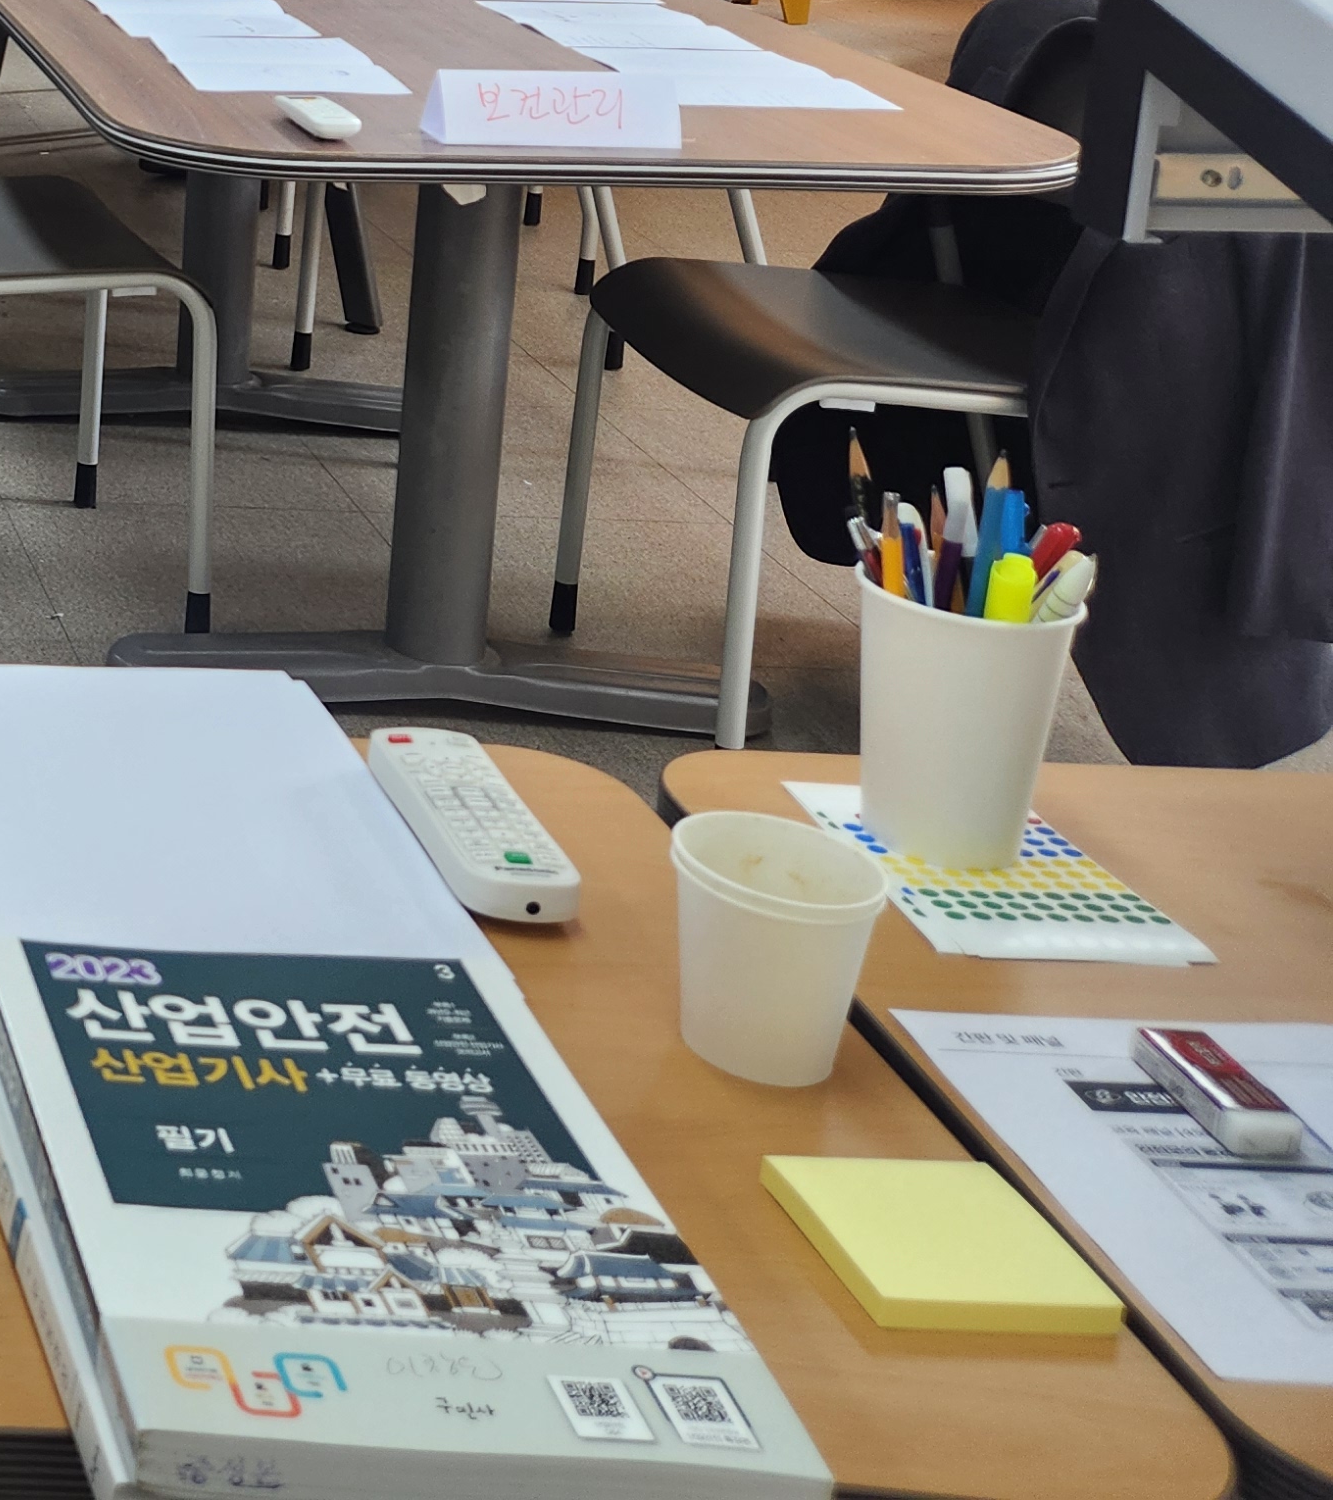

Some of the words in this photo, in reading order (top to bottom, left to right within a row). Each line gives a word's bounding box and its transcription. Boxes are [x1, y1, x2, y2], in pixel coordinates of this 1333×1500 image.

[477, 82, 624, 129] 보건관리
[45, 953, 162, 986] 2023
[65, 988, 424, 1056] 산업안전
[90, 1047, 308, 1093] 산업기사
[404, 1068, 494, 1093] 동영상
[155, 1125, 235, 1154] 필기
